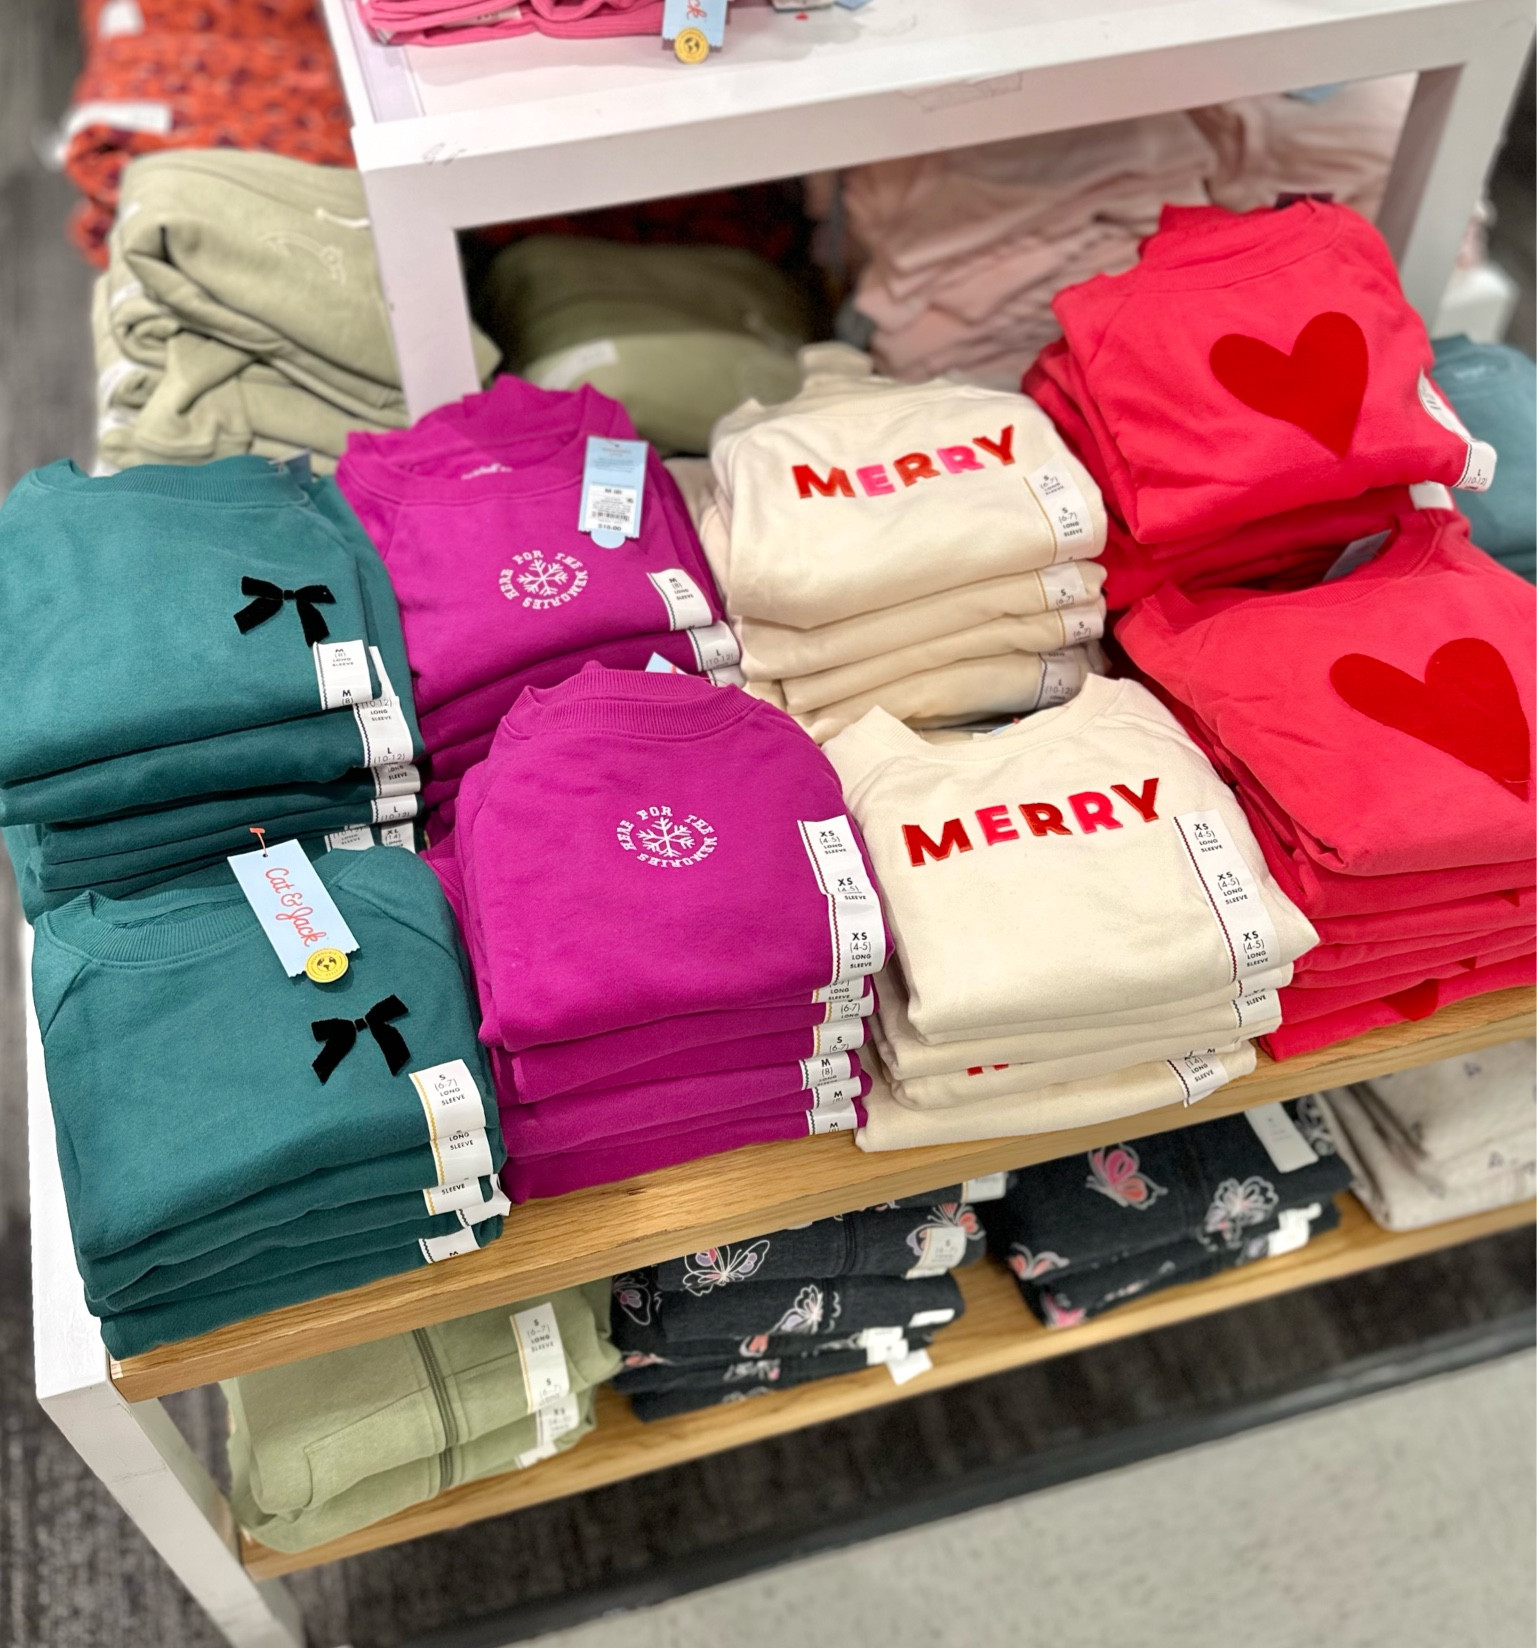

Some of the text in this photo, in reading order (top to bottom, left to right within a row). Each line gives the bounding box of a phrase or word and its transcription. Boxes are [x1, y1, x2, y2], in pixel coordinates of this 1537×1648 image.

[791, 424, 1016, 499] MERRY
[1062, 521, 1079, 529] LONG
[1064, 528, 1082, 537] SLEEVE
[512, 549, 544, 565] FOR
[554, 552, 583, 570] THE
[342, 689, 351, 697] M
[387, 747, 392, 755] L
[373, 753, 405, 765] (10-12)
[388, 772, 408, 780] SLEEVE
[901, 777, 1160, 867] MERRY
[1194, 823, 1209, 831] XS
[617, 805, 718, 868] HERE FOR THE MEMORIES
[1194, 830, 1215, 840] (4-5)
[1199, 838, 1218, 846] LONG
[1200, 844, 1223, 853] SLEEVE
[265, 867, 295, 894] Cat
[837, 877, 853, 886] XS
[1217, 871, 1233, 881] XS
[1218, 877, 1240, 891] (4-5)
[1223, 887, 1243, 897] LONG
[281, 892, 303, 907] &
[1225, 894, 1248, 905] SLEEVE
[275, 906, 327, 947] Jack
[852, 932, 867, 941] XS
[1243, 930, 1259, 941] XS
[850, 941, 871, 953] (4-5)
[1243, 938, 1265, 954] (4-5)
[1247, 950, 1266, 960] LONG
[1246, 957, 1269, 967] SLEEVE
[1246, 994, 1266, 1006] SLEEVE
[840, 1003, 861, 1014] (6-7)
[821, 1058, 831, 1067] M
[822, 1066, 833, 1077] (8)
[1191, 1063, 1208, 1074] LONG
[1194, 1069, 1214, 1082] SLEEVE
[439, 1087, 461, 1097] LONG
[834, 1090, 843, 1098] M
[441, 1094, 466, 1106] SLEEVE
[449, 1131, 470, 1142] LONG
[449, 1139, 474, 1151] SLEEVE
[441, 1183, 466, 1195] SLEEVE
[534, 1319, 539, 1327] S
[527, 1324, 550, 1338] (6-7)
[530, 1334, 550, 1344] LONG
[531, 1341, 554, 1353] SLEEVE
[546, 1378, 551, 1386] S
